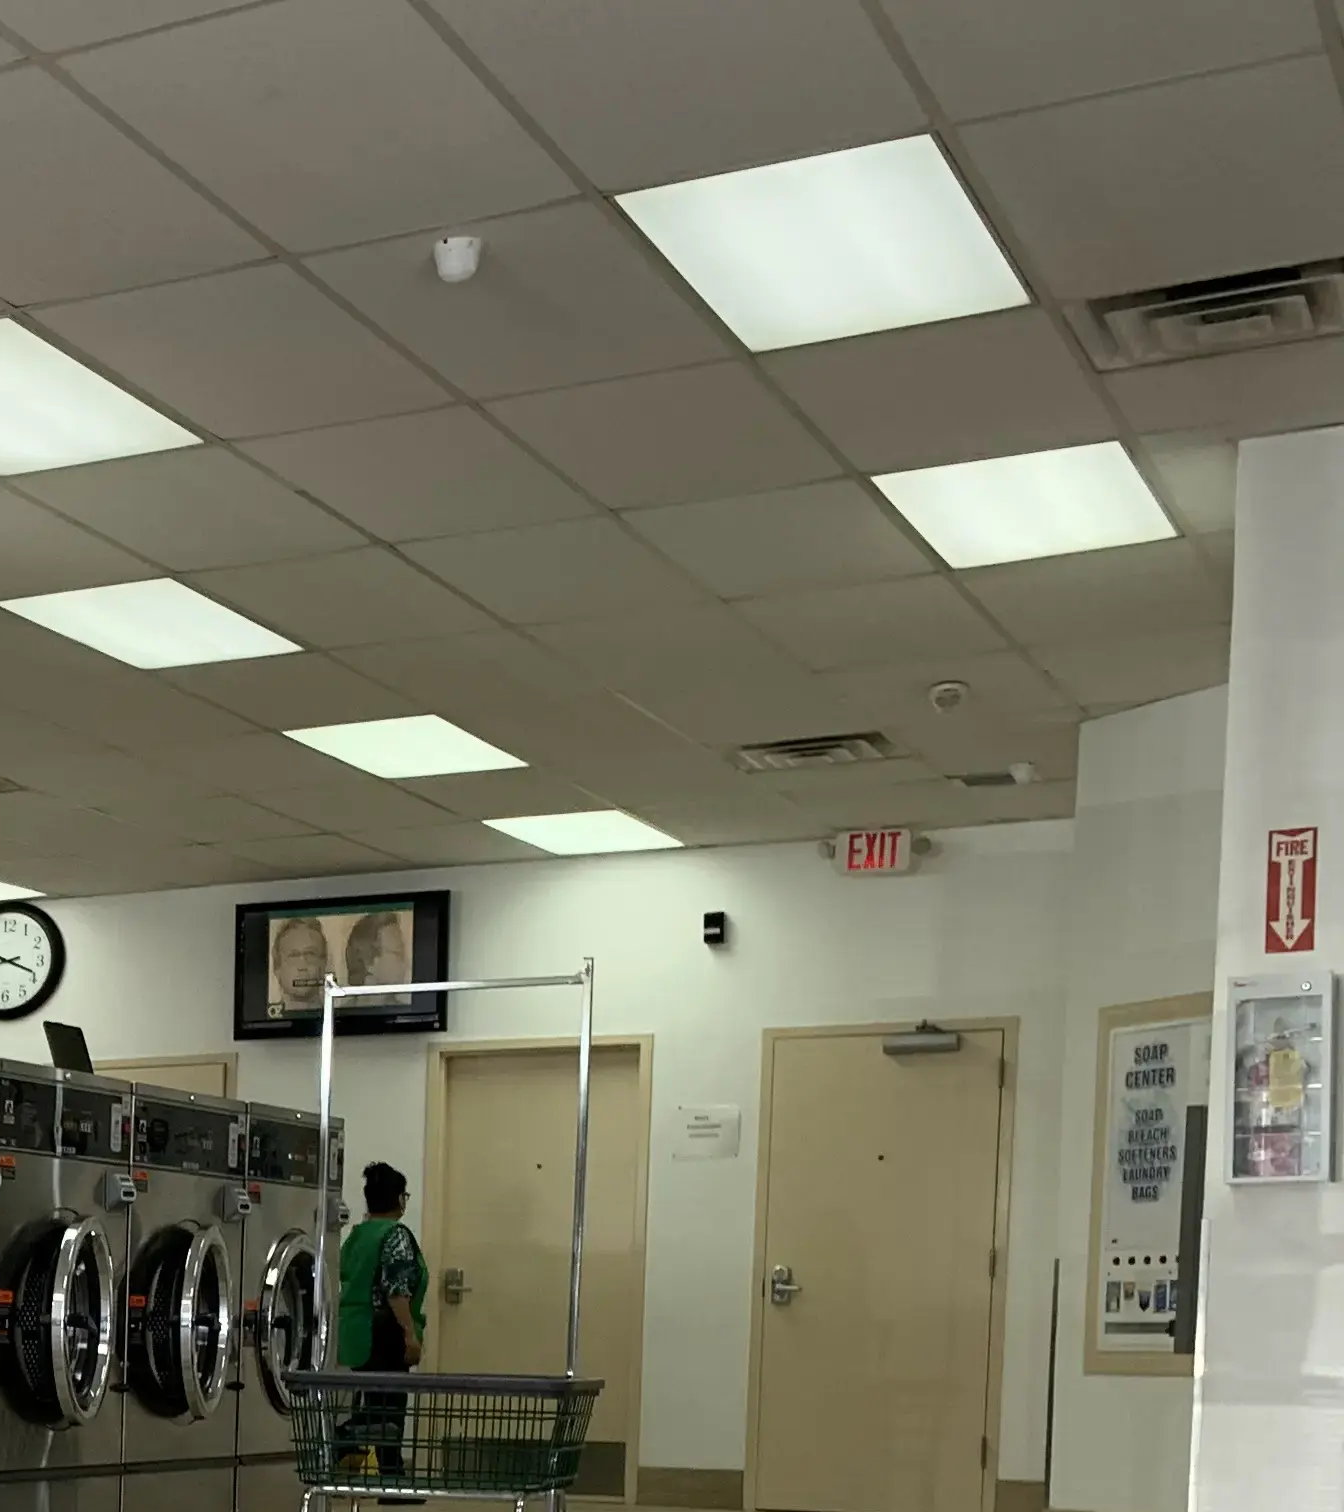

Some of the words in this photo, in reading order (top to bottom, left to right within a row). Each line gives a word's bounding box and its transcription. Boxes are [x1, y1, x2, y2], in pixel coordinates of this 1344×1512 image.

[848, 831, 902, 872] EXIT
[1276, 839, 1309, 858] FIRE
[4, 919, 17, 933] 12
[33, 936, 42, 949] 2
[36, 954, 44, 967] 3
[1, 989, 10, 1003] 6
[18, 984, 27, 998] 5
[1134, 1043, 1169, 1066] SOAP
[1125, 1066, 1176, 1091] CENTER
[1134, 1108, 1164, 1126] SOAP
[1127, 1127, 1170, 1145] BLEACH
[1118, 1146, 1178, 1166] SOFTENERS
[1123, 1167, 1171, 1185] LAUNDRY
[1131, 1185, 1159, 1202] BAGS
